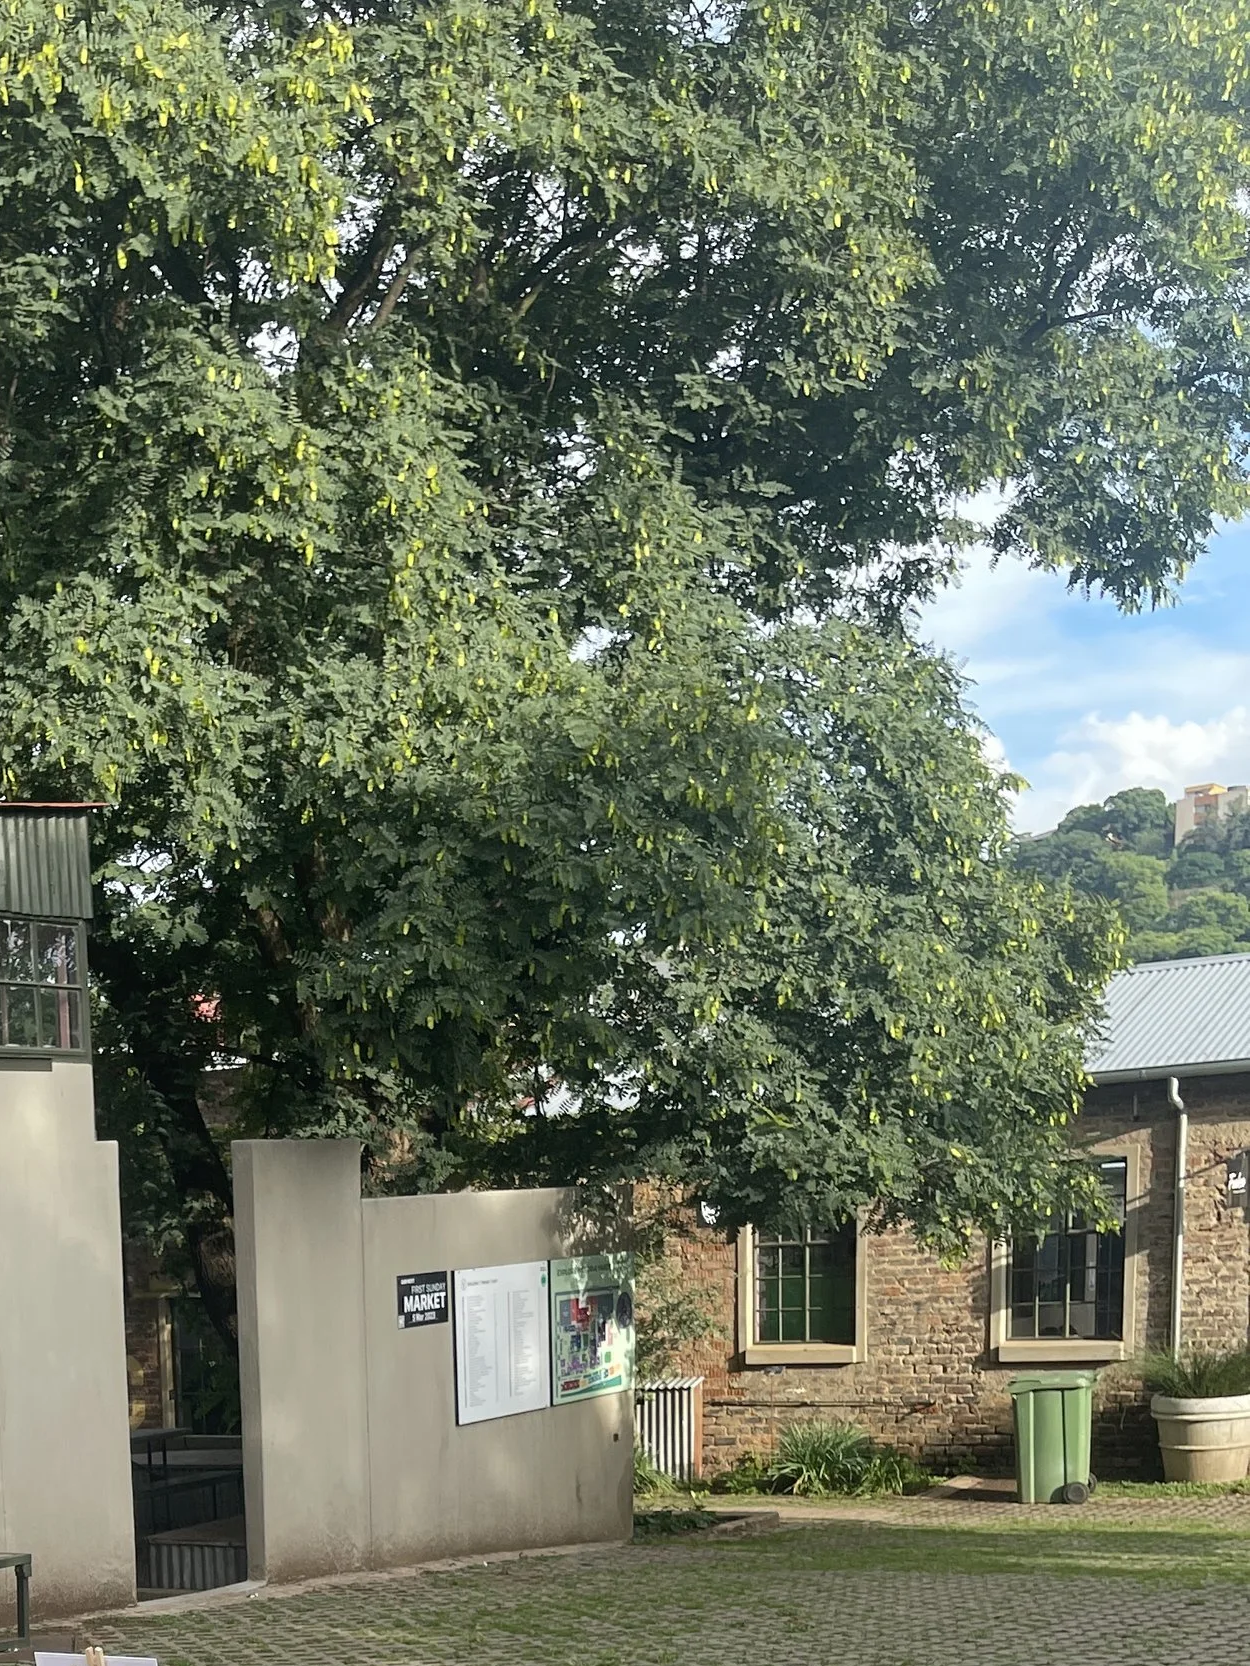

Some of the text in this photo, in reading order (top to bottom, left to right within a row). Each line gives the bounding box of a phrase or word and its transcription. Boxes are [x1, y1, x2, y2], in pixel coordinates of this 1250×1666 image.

[411, 1282, 446, 1294] FIRST SUNDAY
[403, 1291, 446, 1313] MARKET
